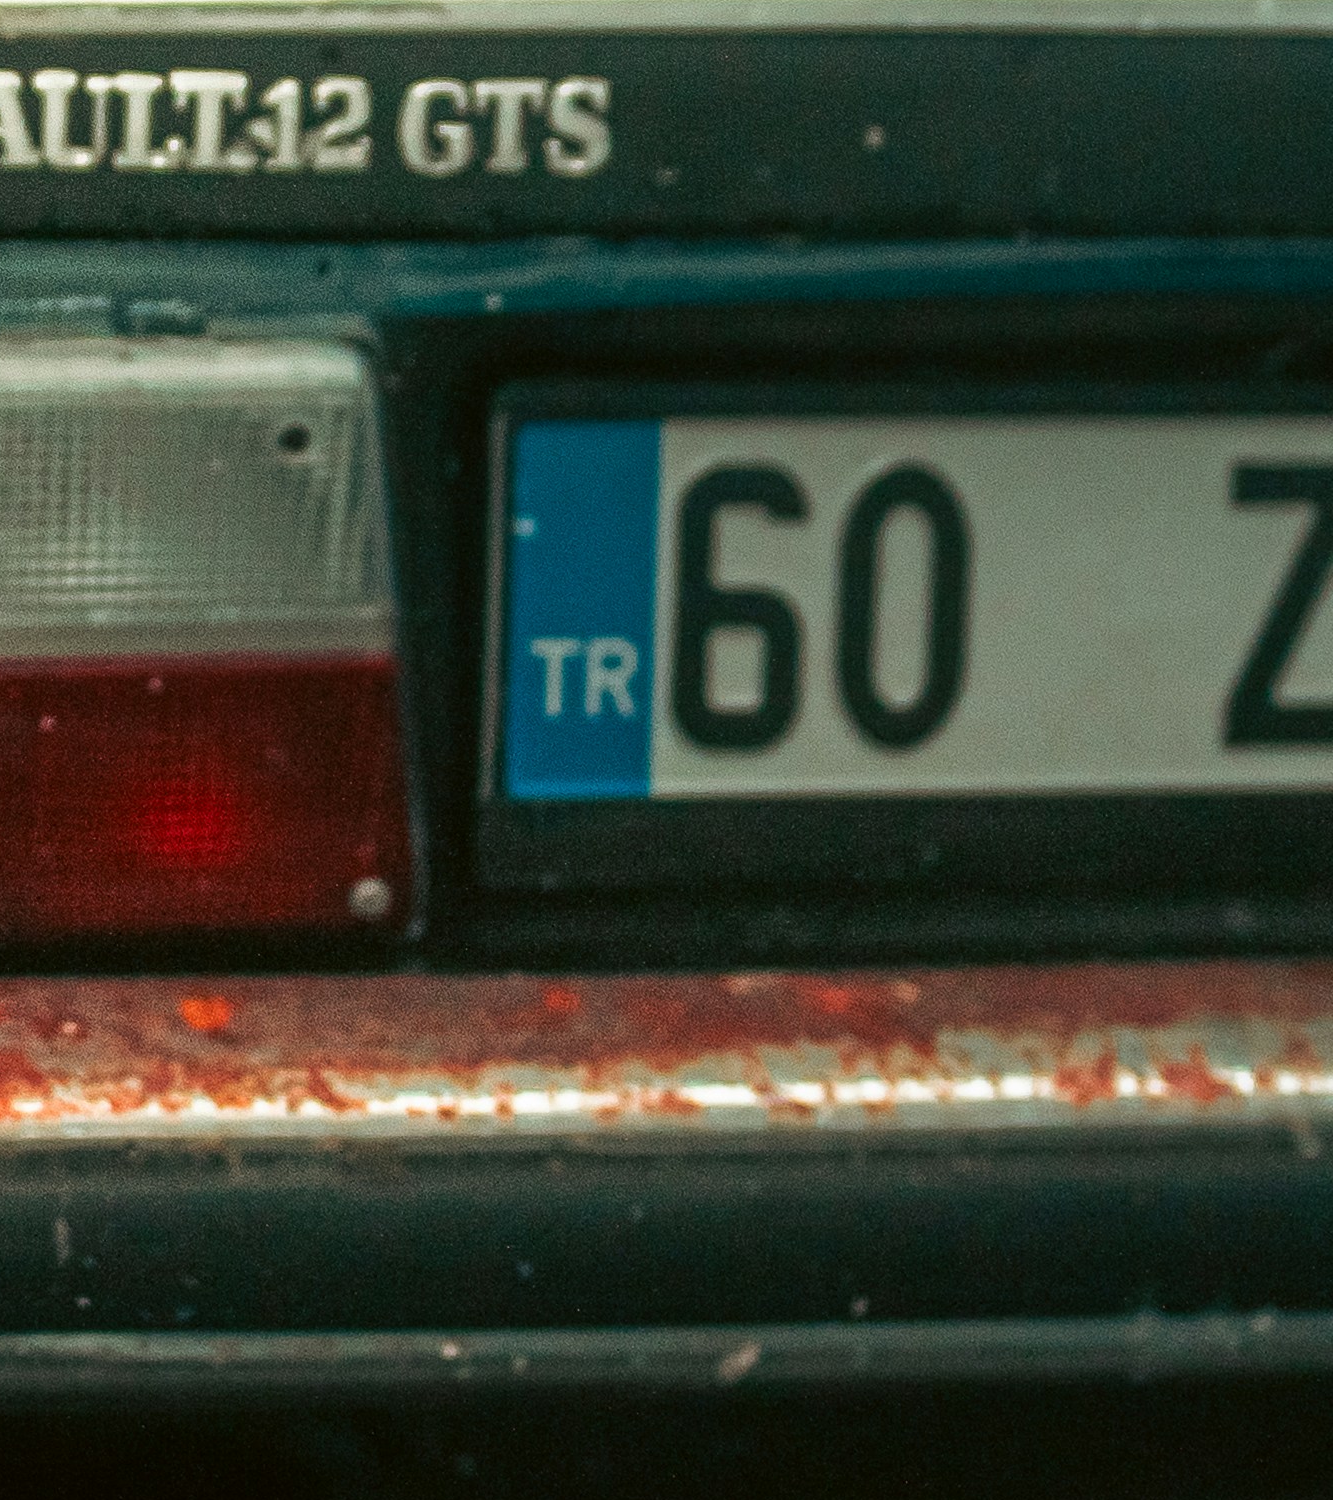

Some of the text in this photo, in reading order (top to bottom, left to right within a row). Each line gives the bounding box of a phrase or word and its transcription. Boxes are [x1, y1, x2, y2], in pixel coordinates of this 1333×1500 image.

[397, 78, 613, 178] GTS
[673, 461, 973, 753] 60
[531, 638, 640, 717] TR
